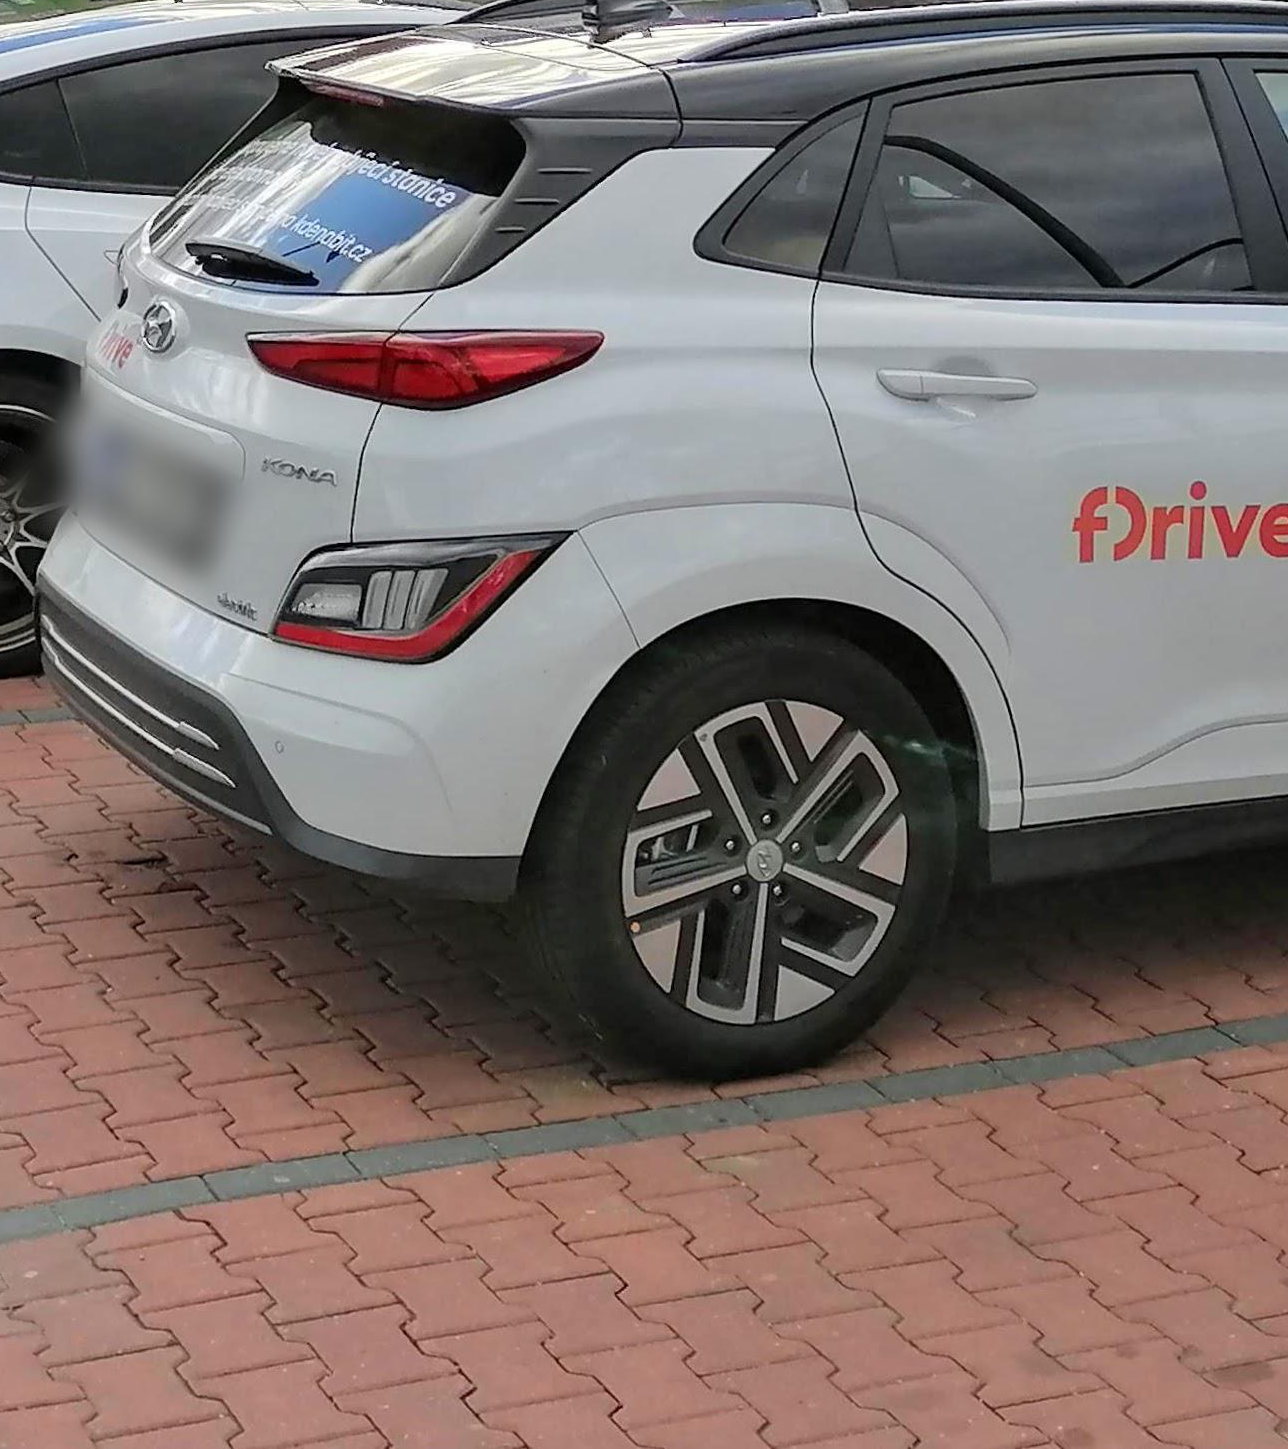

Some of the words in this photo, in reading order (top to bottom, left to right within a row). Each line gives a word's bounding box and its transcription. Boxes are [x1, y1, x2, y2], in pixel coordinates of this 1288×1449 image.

[381, 167, 457, 208] stanice
[291, 214, 373, 263] kdenabit.cz
[261, 456, 338, 487] KONA
